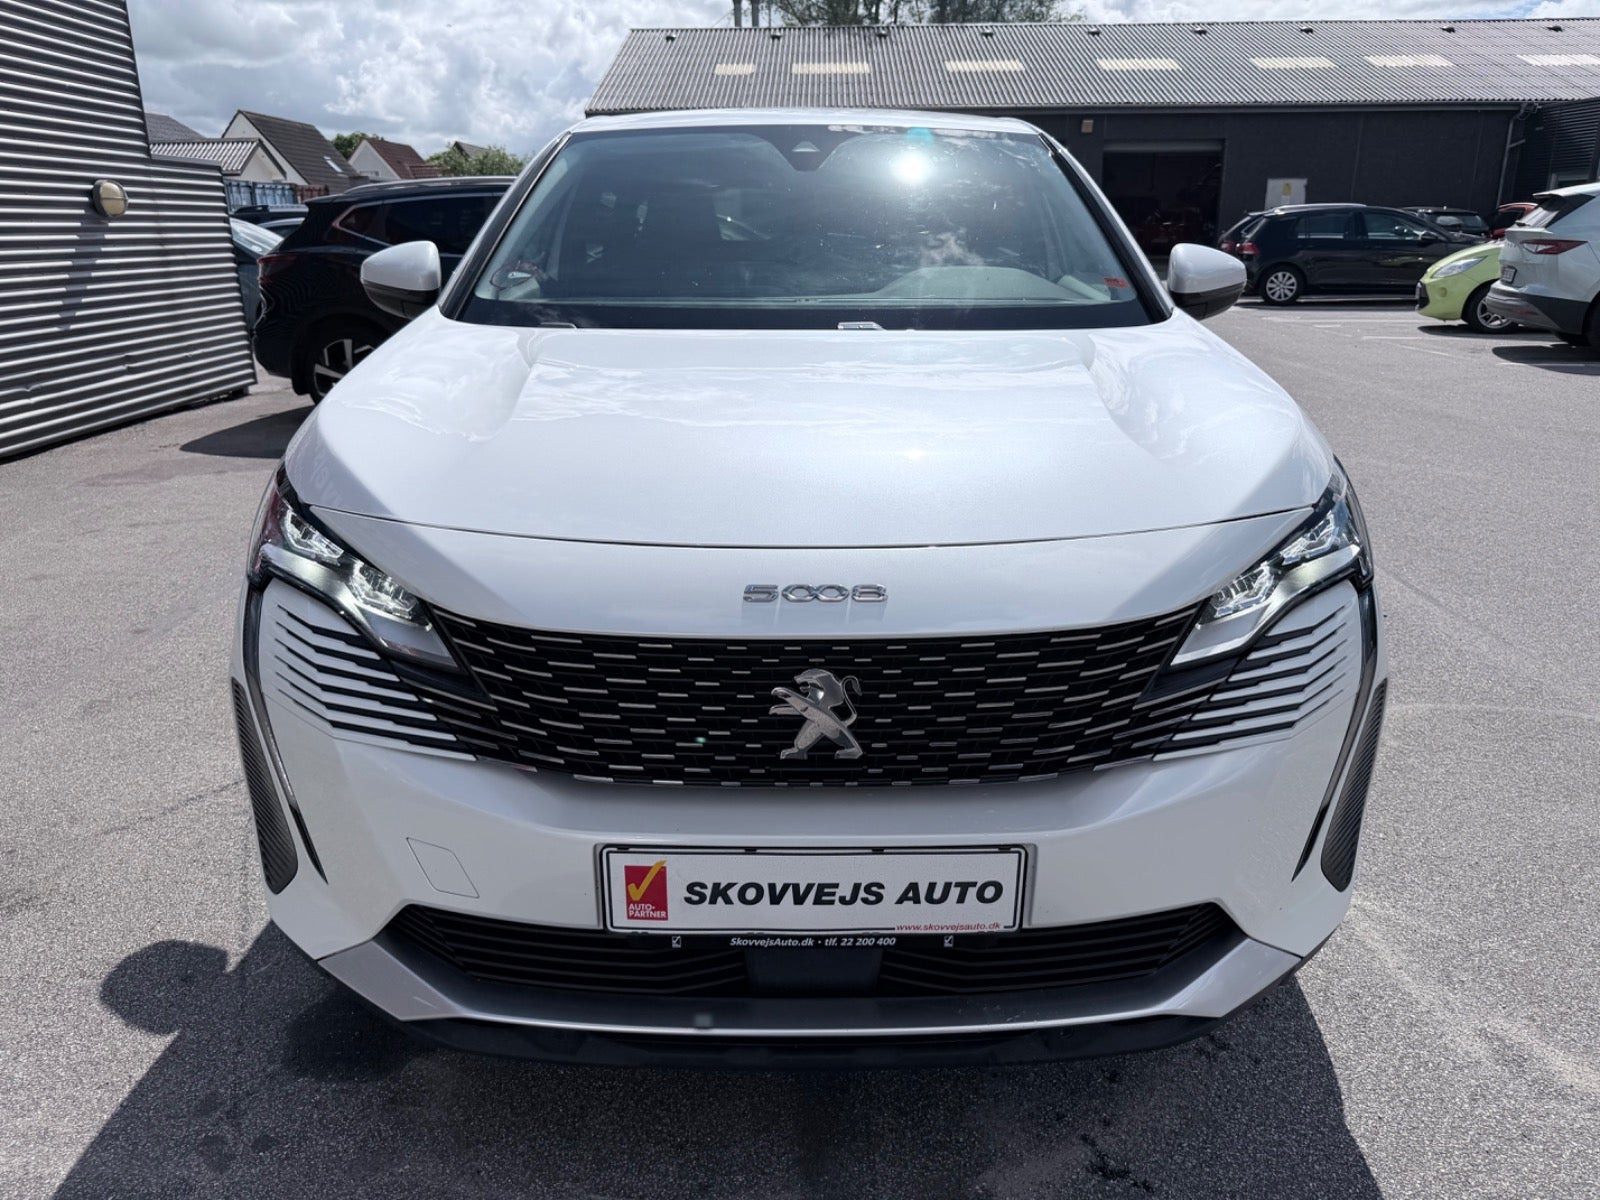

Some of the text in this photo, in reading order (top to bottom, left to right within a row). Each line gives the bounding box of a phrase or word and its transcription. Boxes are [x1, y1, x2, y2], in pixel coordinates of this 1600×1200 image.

[743, 584, 888, 602] 5008
[684, 880, 1004, 906] SKOVVEJS AUTO
[629, 910, 667, 918] PARTNER
[896, 922, 1001, 932] www.skovvejsauto.dk
[730, 937, 896, 948] SkovvejsAuto.dk tlf. 22 200 400
